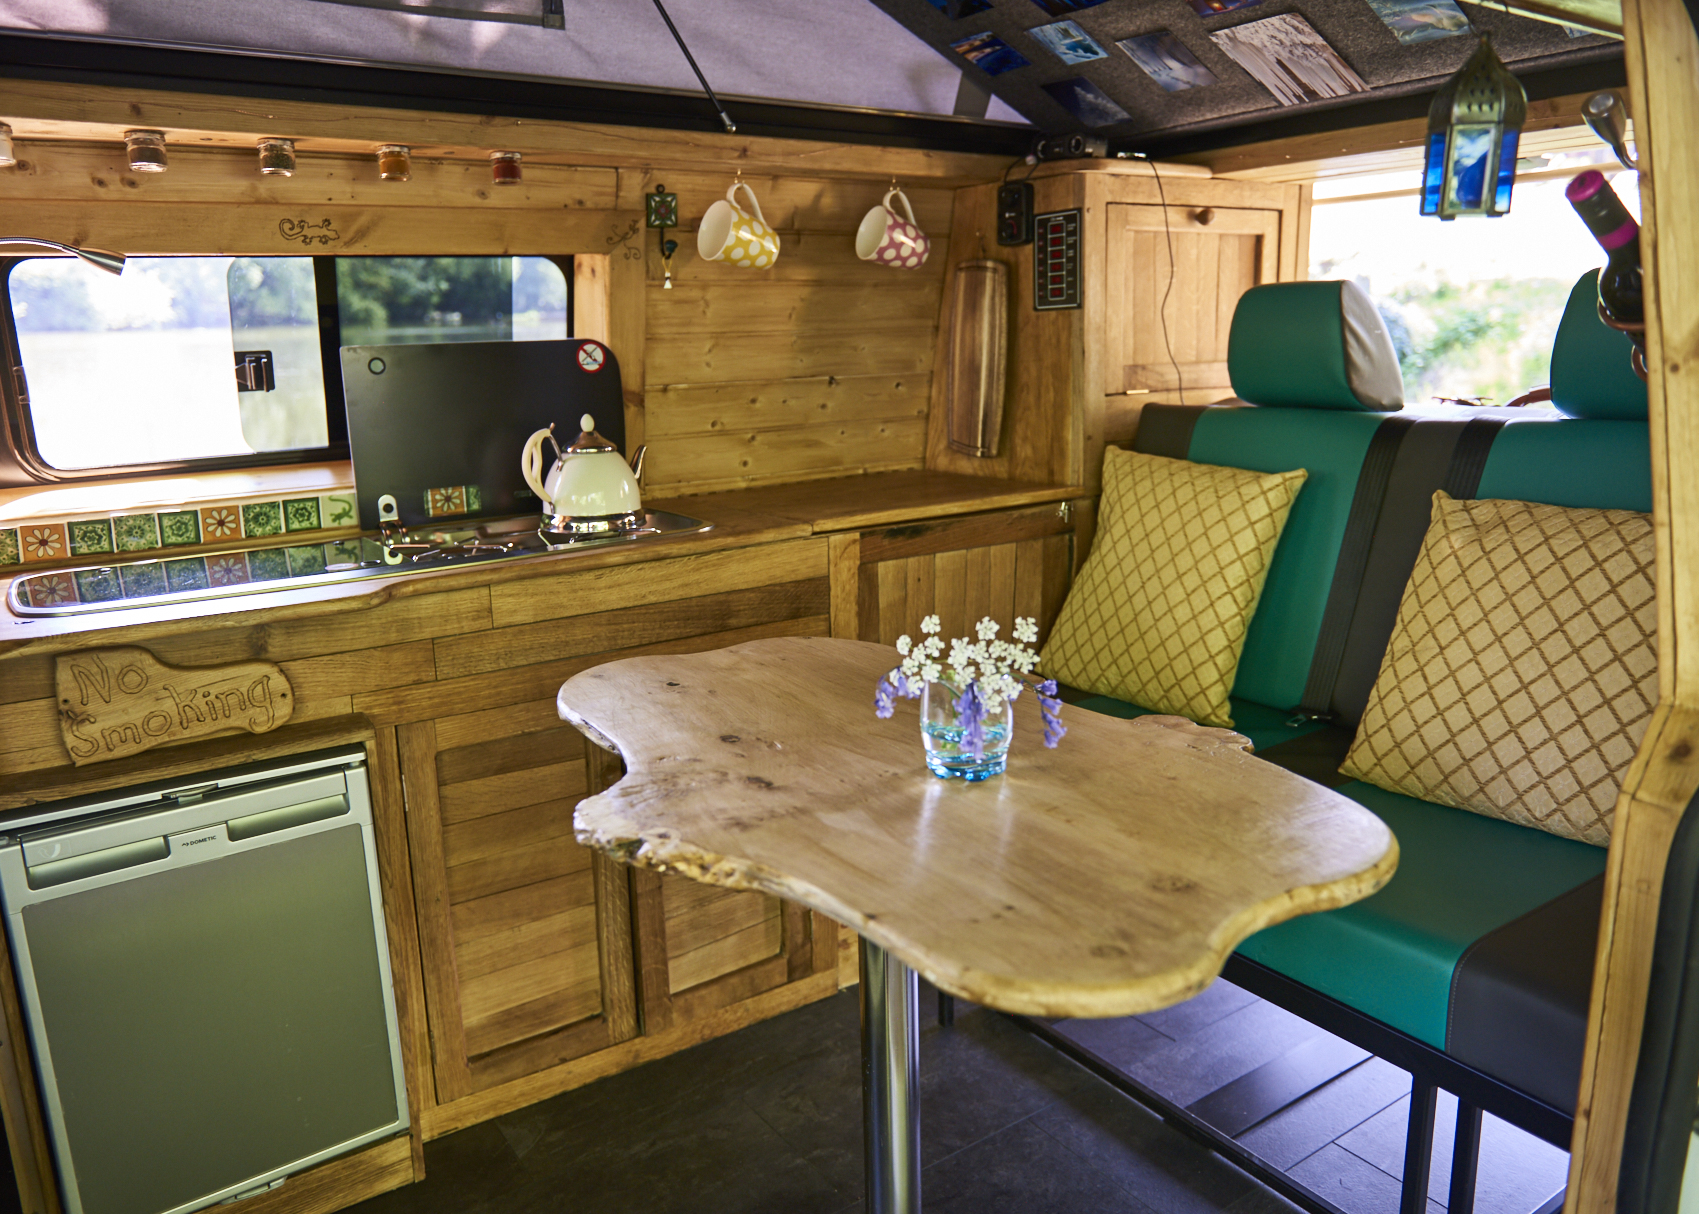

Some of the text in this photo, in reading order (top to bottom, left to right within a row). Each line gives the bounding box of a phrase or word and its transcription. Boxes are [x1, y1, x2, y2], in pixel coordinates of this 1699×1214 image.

[70, 653, 149, 706] No
[68, 675, 275, 758] Smoking
[190, 835, 217, 846] DOMETIC
